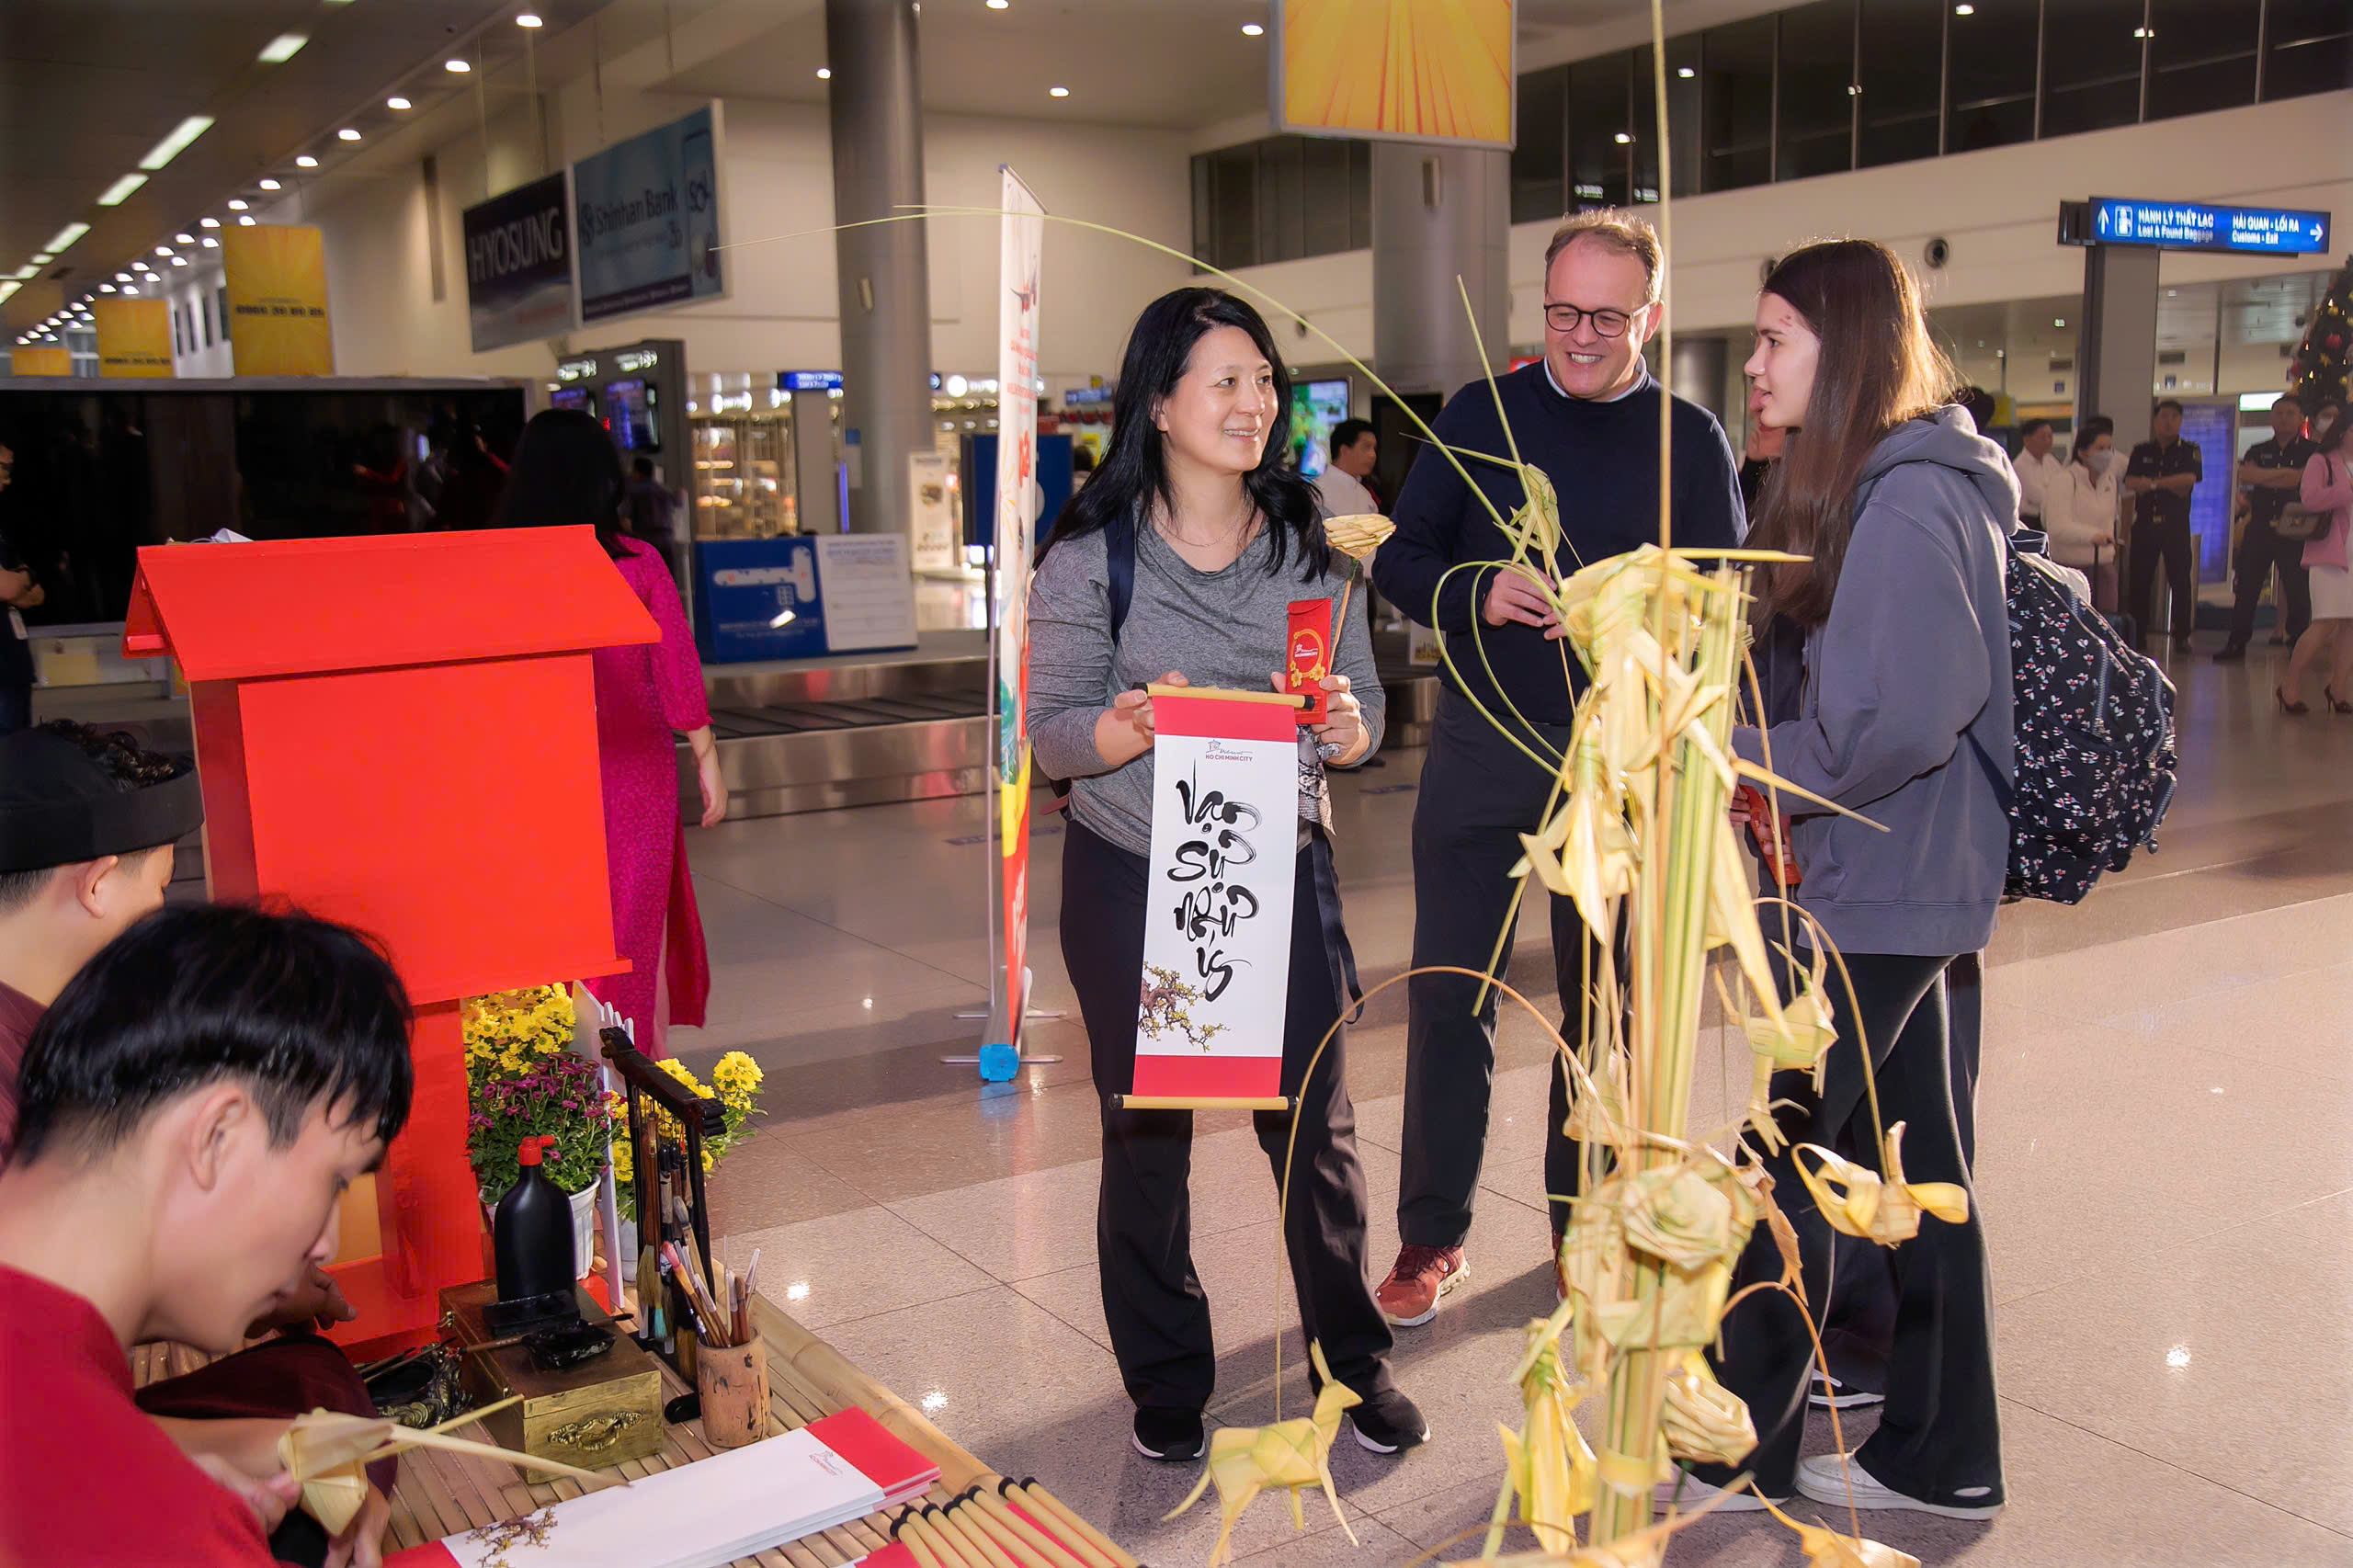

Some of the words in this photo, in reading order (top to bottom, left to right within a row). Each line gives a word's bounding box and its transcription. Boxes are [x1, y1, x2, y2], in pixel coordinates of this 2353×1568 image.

[597, 199, 643, 232] Shinhan
[645, 183, 678, 218] Bank
[2138, 223, 2154, 238] Lost
[2162, 225, 2183, 239] Found
[2184, 226, 2214, 244] Baggage
[2247, 215, 2269, 231] QUAN
[2289, 218, 2300, 233] RA
[471, 208, 563, 278] HYOSUNG
[2233, 230, 2260, 244] Customs
[2266, 232, 2279, 244] Exit
